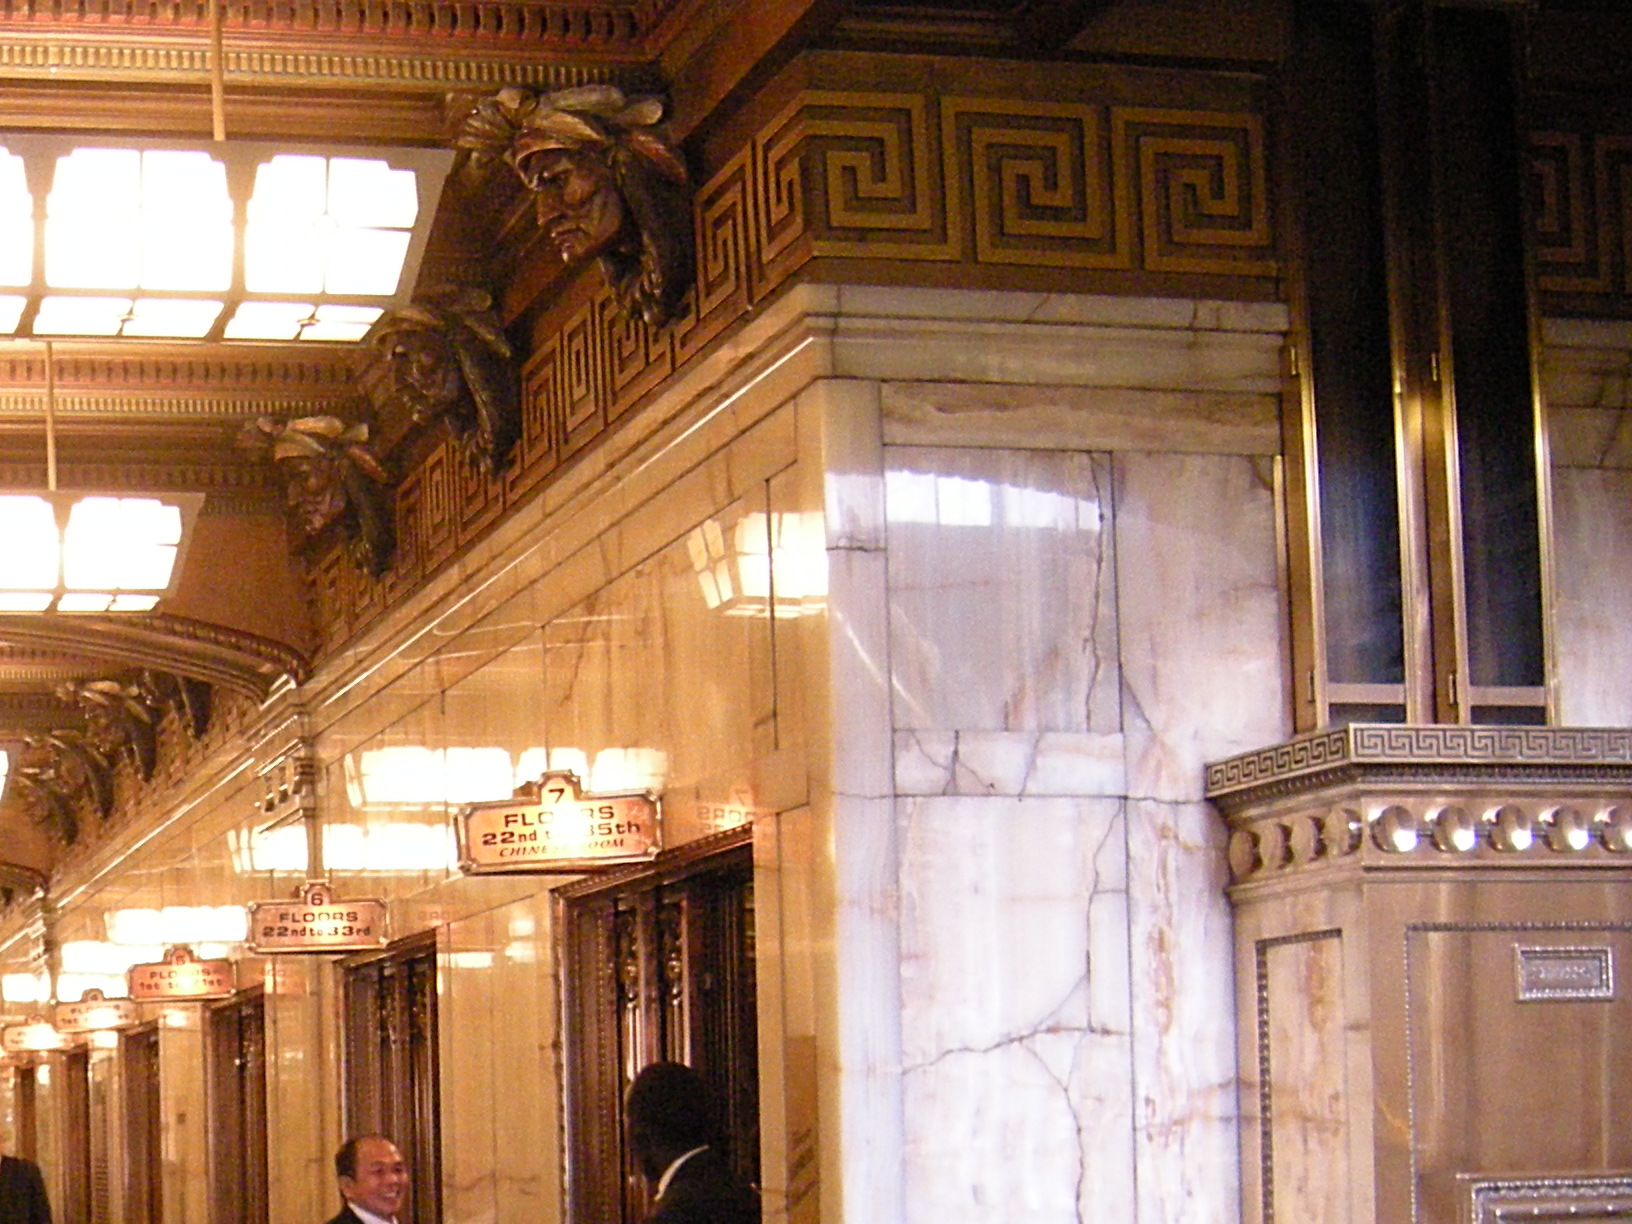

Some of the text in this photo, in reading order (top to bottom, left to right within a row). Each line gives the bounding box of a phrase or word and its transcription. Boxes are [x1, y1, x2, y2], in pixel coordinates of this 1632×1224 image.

[548, 788, 566, 804] 7
[503, 805, 615, 828] FLORS
[481, 829, 538, 846] 22nd
[310, 892, 324, 906] 6
[278, 911, 359, 923] FLOORS
[262, 926, 307, 938] 22nd
[328, 925, 371, 937] 33rd
